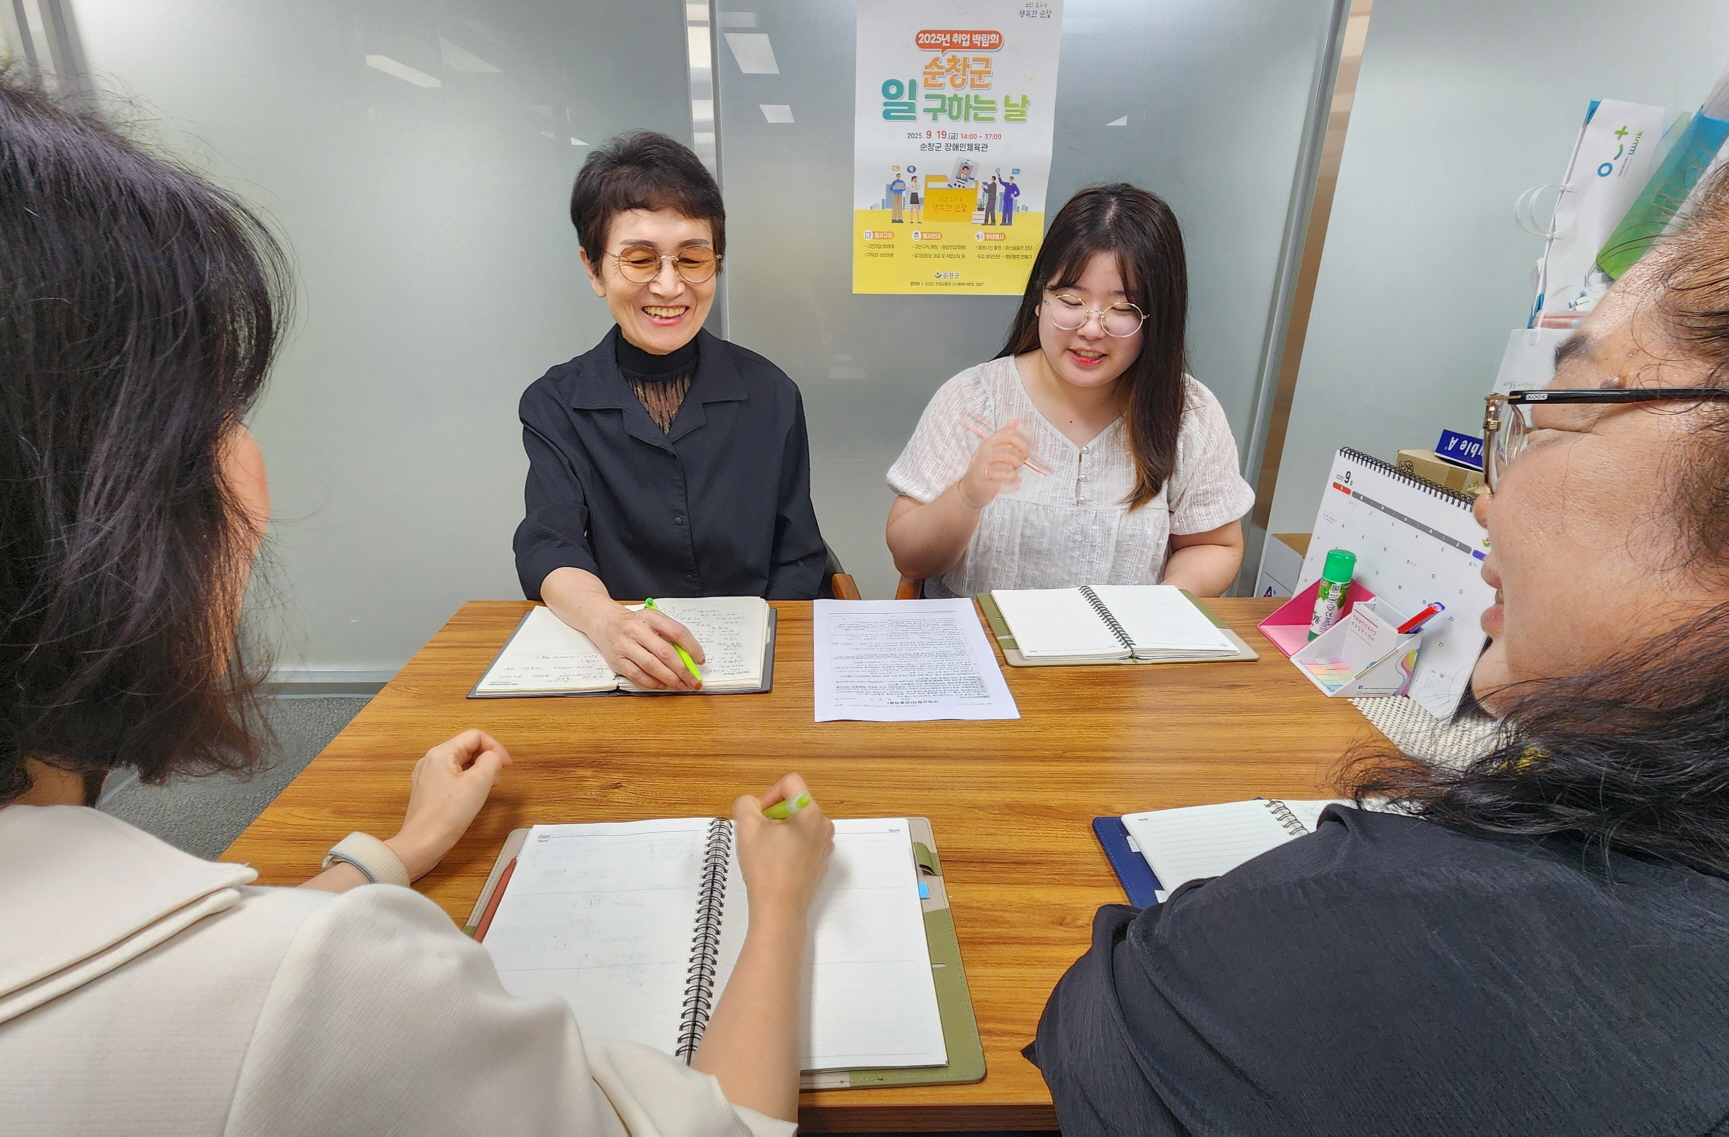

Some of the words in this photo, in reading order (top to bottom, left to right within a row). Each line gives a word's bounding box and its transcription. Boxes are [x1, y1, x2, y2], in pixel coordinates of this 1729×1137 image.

[918, 33, 950, 47] 2025년
[952, 33, 970, 47] 취업
[972, 33, 1000, 46] 박람회
[923, 54, 992, 88] 순창군
[881, 78, 917, 121] 일
[923, 93, 997, 122] 구하는
[1004, 94, 1030, 122] 날
[920, 142, 942, 152] 순창군
[944, 142, 989, 152] 장애인체육관
[1344, 470, 1352, 484] 9
